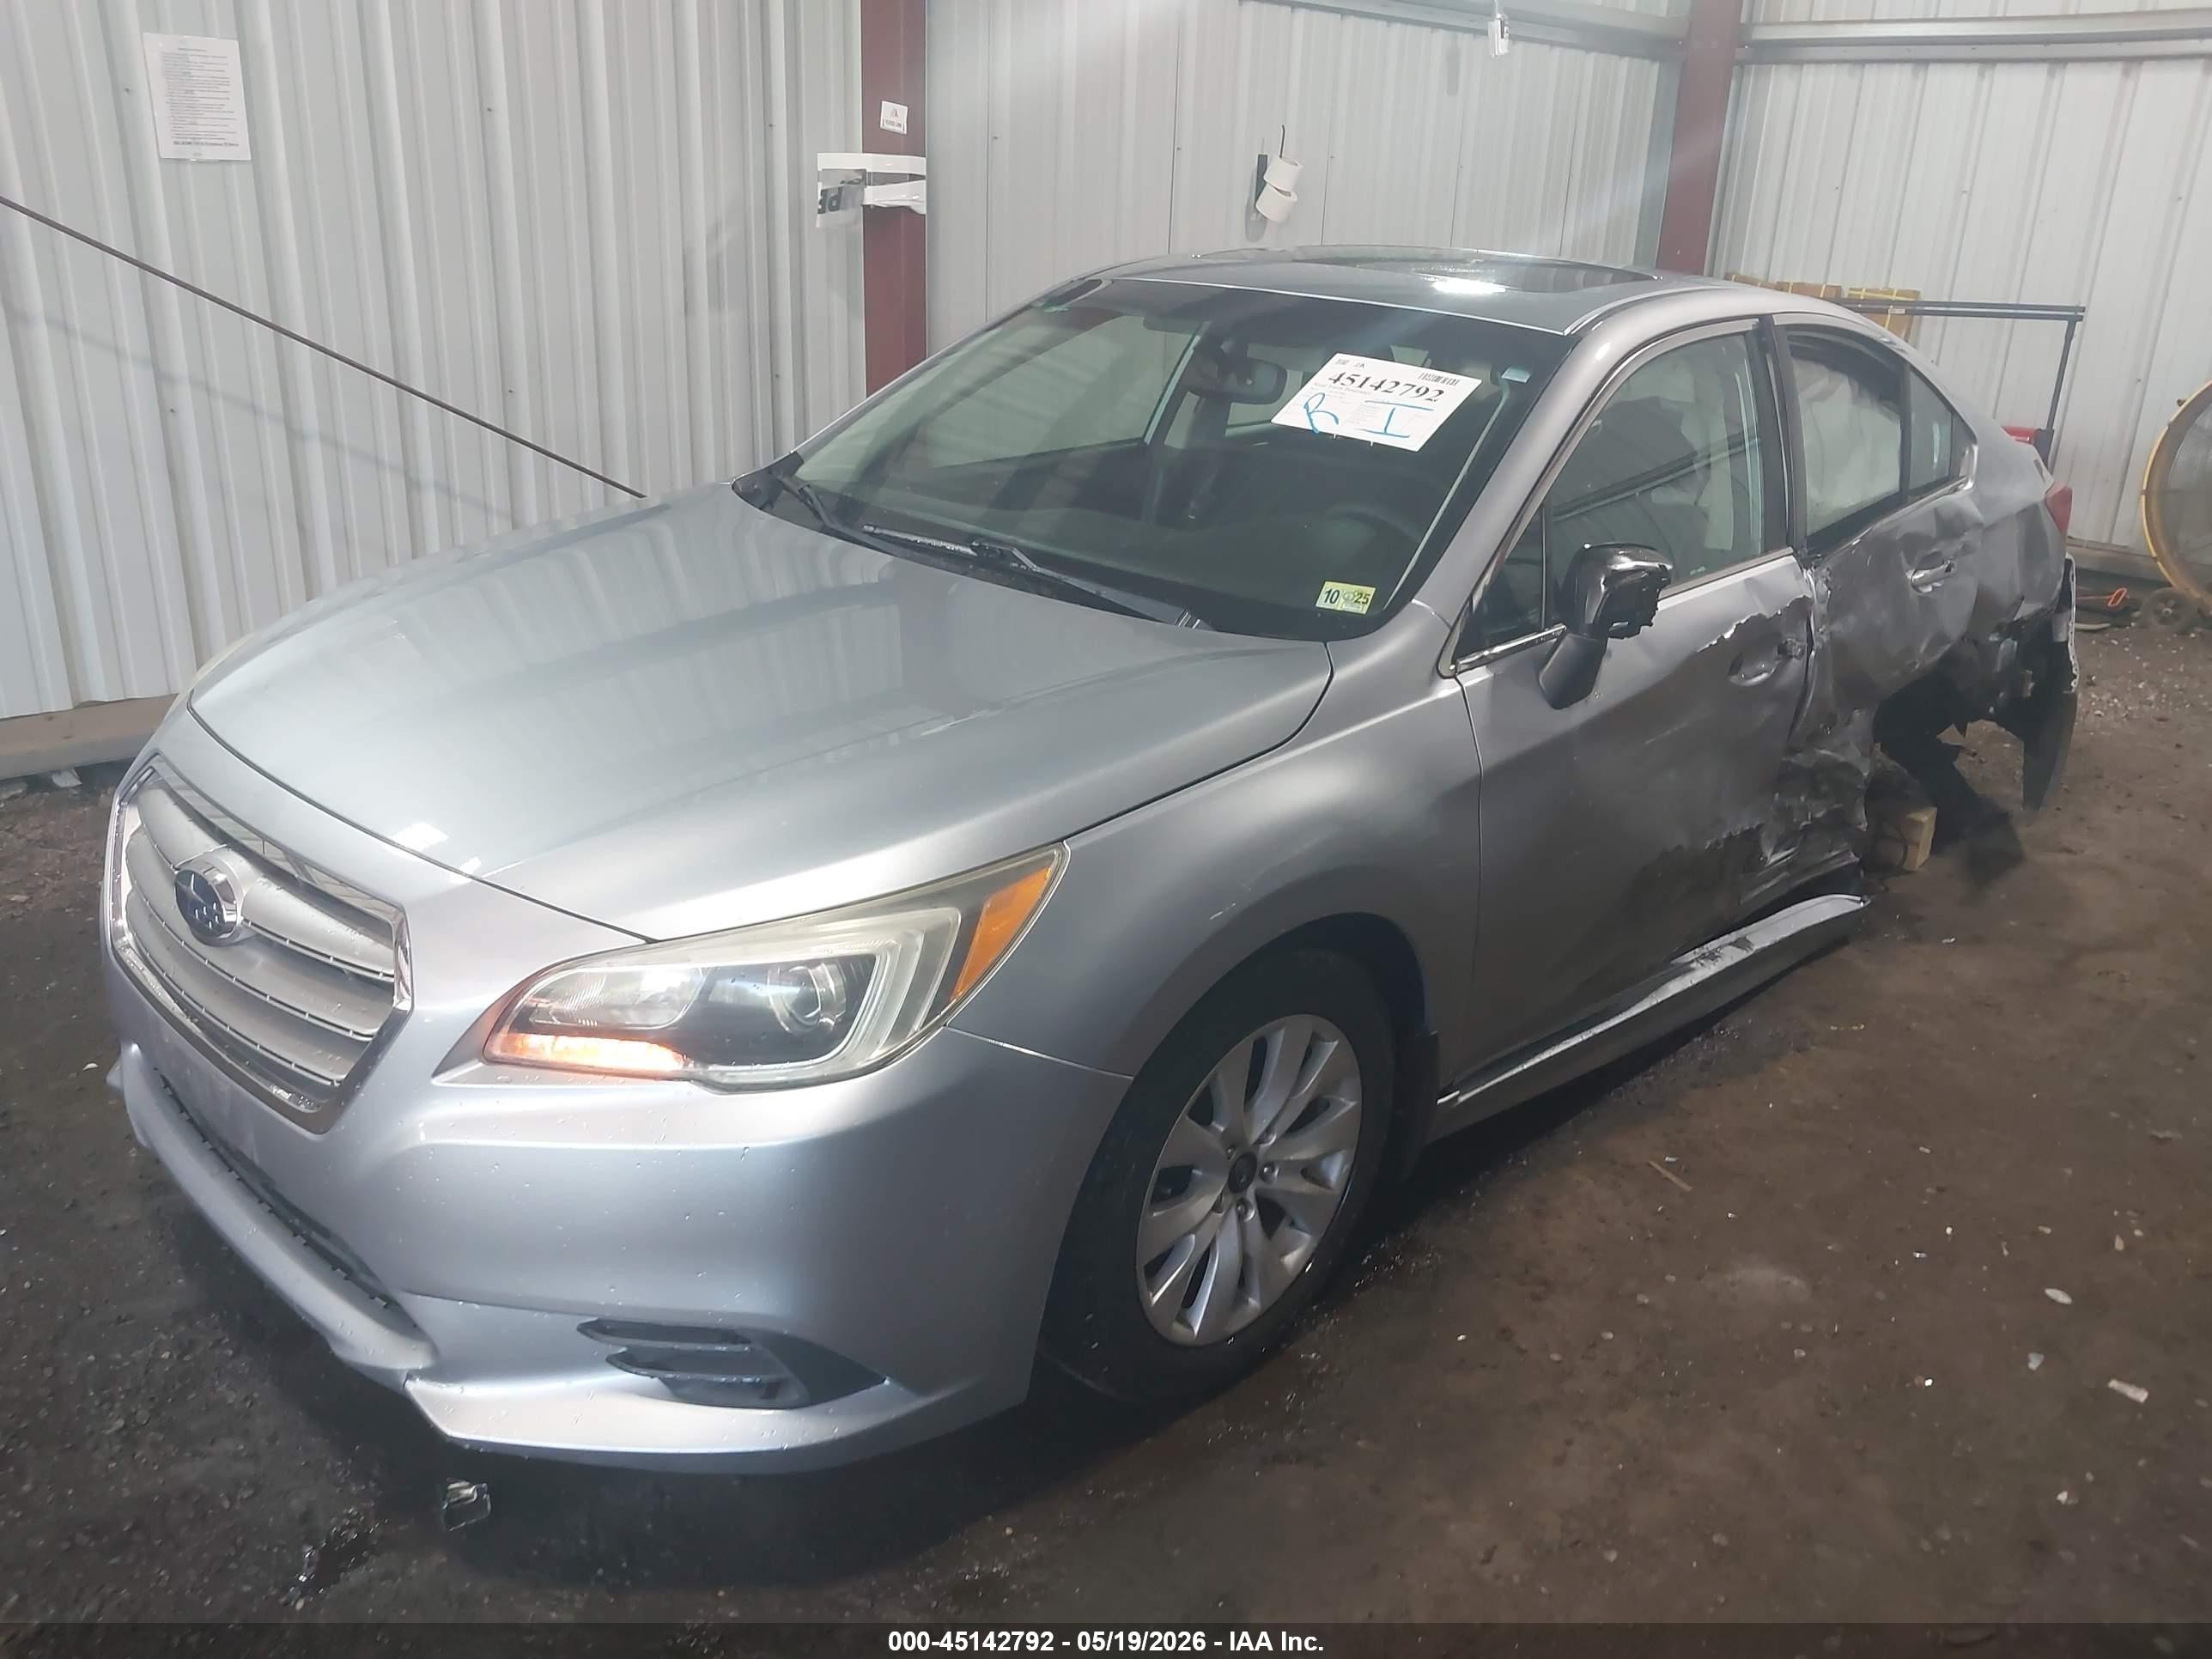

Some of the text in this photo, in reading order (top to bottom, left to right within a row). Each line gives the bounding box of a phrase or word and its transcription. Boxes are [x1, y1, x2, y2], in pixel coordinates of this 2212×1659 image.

[1328, 372, 1445, 403] 45142792
[1324, 588, 1371, 605] 10 25
